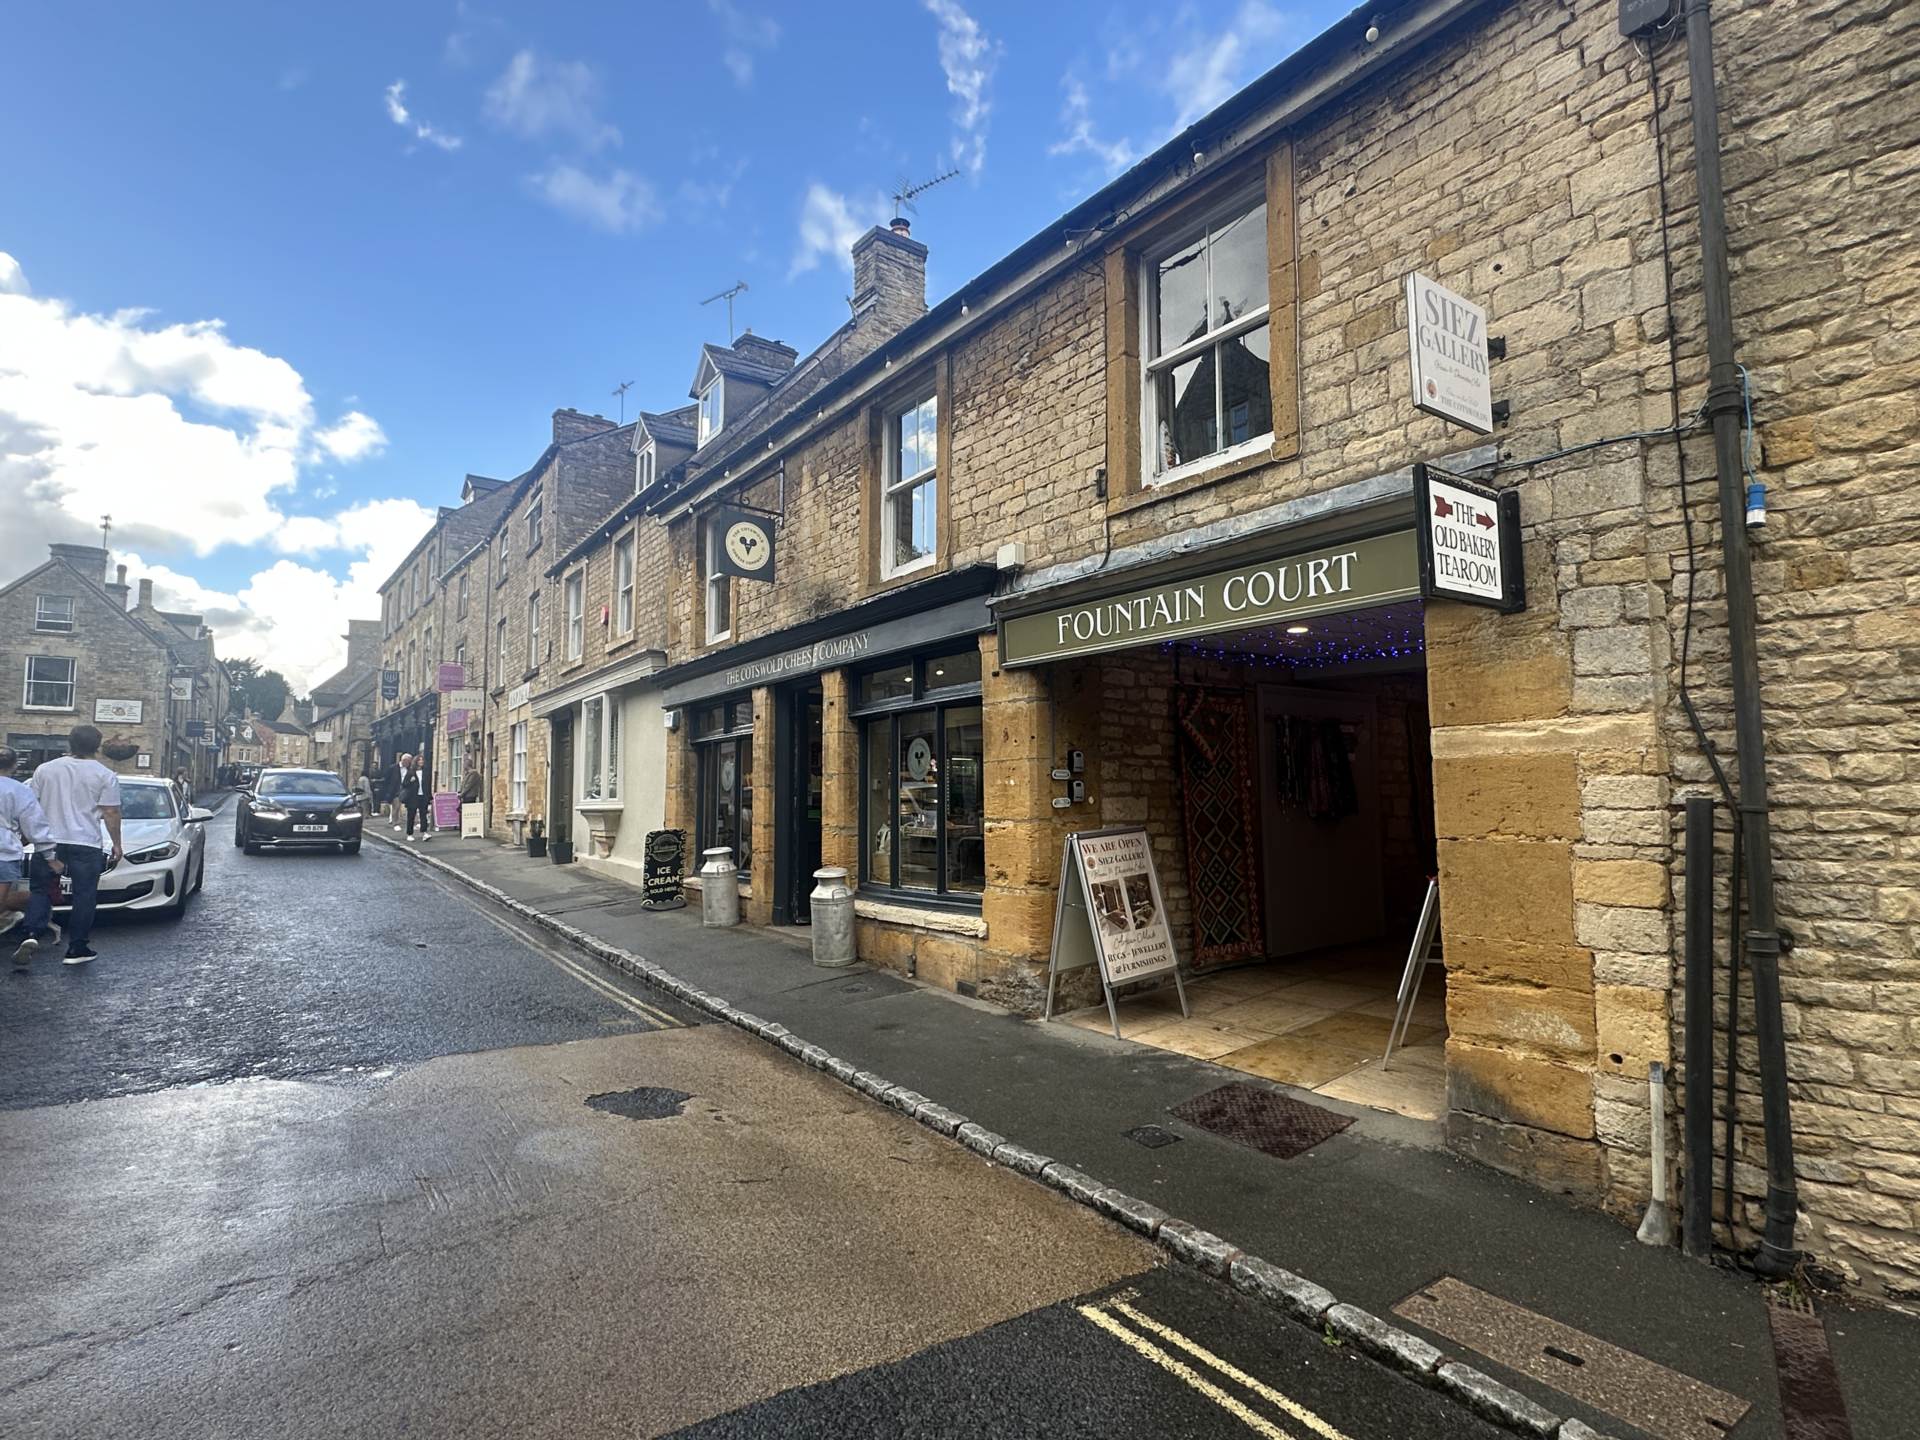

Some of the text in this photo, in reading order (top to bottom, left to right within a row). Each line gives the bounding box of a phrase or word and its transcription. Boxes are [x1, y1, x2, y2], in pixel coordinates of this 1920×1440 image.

[1425, 289, 1480, 347] SIEZ
[1420, 325, 1487, 376] GALLERY
[1453, 501, 1476, 527] THE
[1434, 525, 1497, 560] OLD BAKERY
[1437, 552, 1497, 587] TEAROOM
[1057, 552, 1358, 645] FOUNTAIN COURT
[725, 632, 870, 685] THE COTSWOLD CHEESE COMPANY
[1082, 838, 1143, 854] WE ARE OPEN
[1115, 851, 1145, 863] GALLERY
[648, 875, 680, 886] CREAM
[657, 866, 672, 875] ICE
[1107, 952, 1127, 962] RUGS
[1131, 942, 1167, 957] JEWELLERY
[1122, 955, 1167, 972] FURNISHINGS
